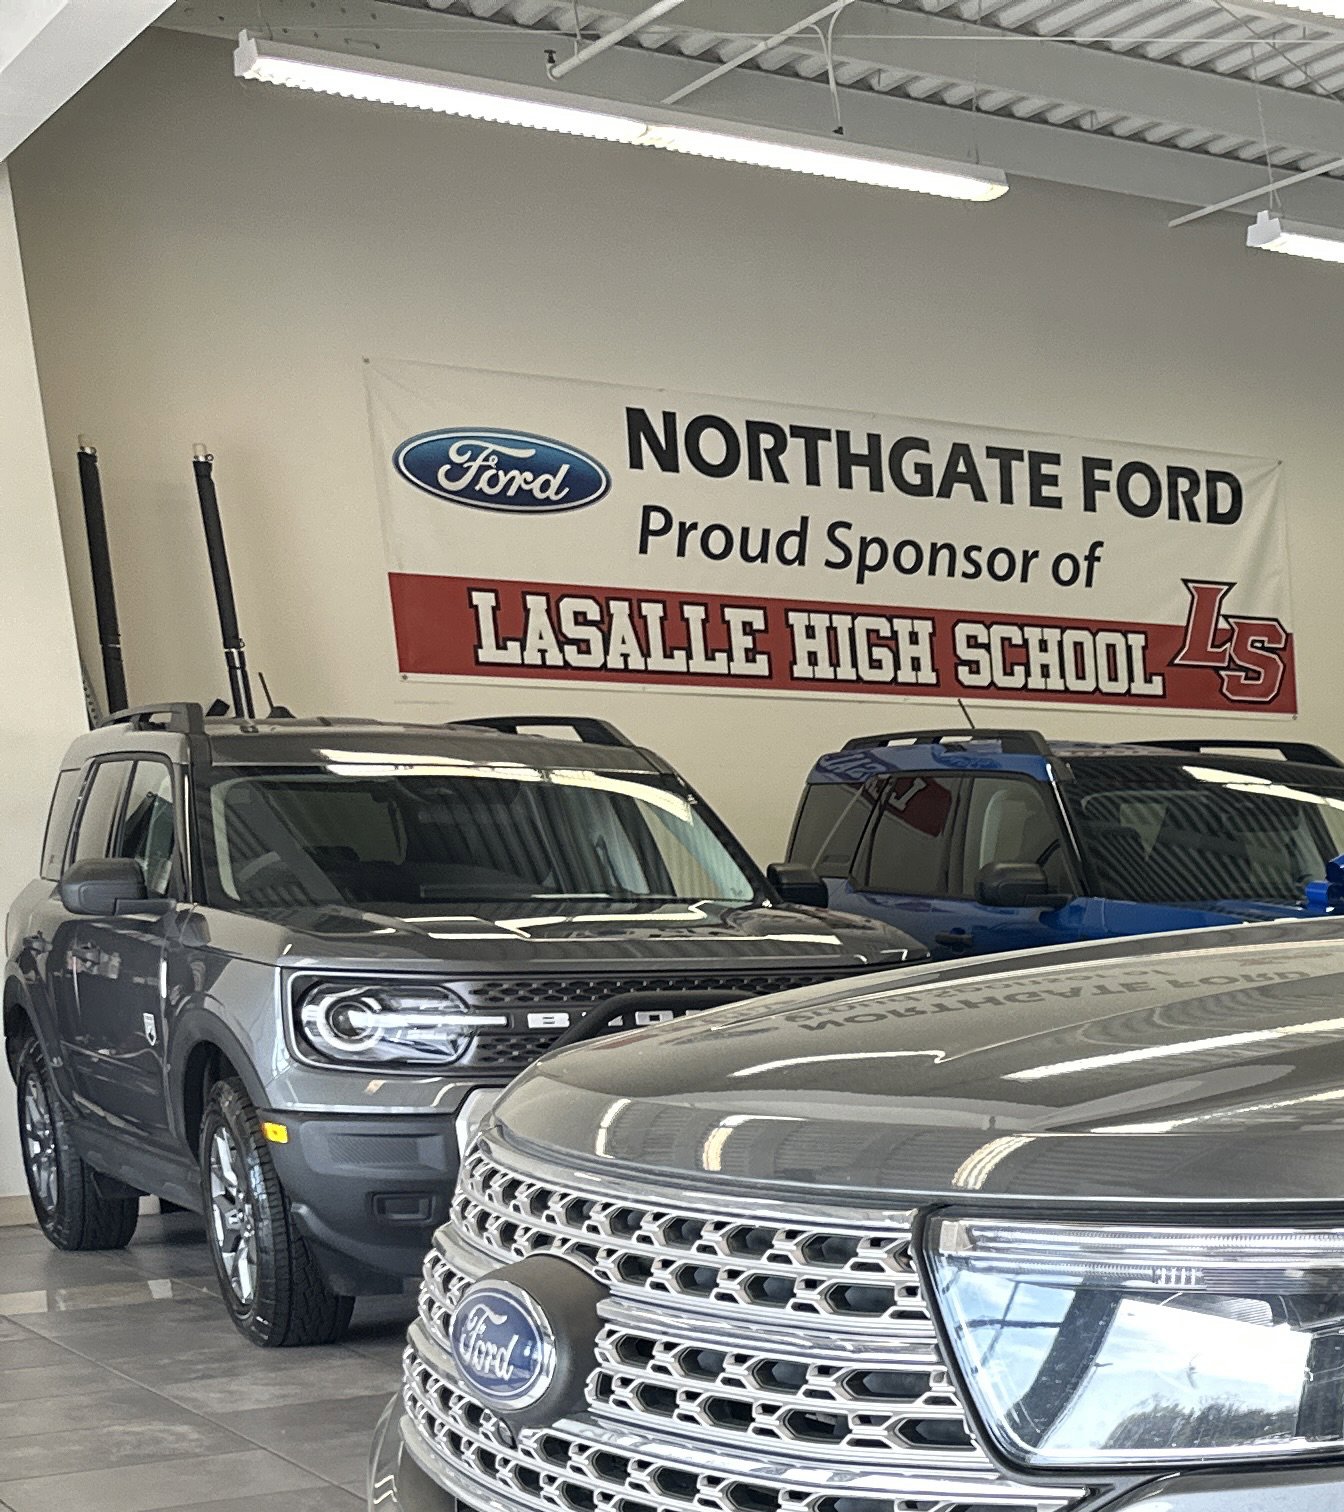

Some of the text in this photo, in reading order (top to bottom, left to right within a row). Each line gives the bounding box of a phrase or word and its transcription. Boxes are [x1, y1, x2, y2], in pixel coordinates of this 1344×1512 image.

[437, 437, 570, 502] Ford
[624, 406, 1245, 527] NORTHGATE FORD
[637, 504, 1104, 589] Proud Sponsor of
[468, 589, 1166, 699] LASALLE HIGH SCHOOL
[459, 1303, 520, 1382] Ford
